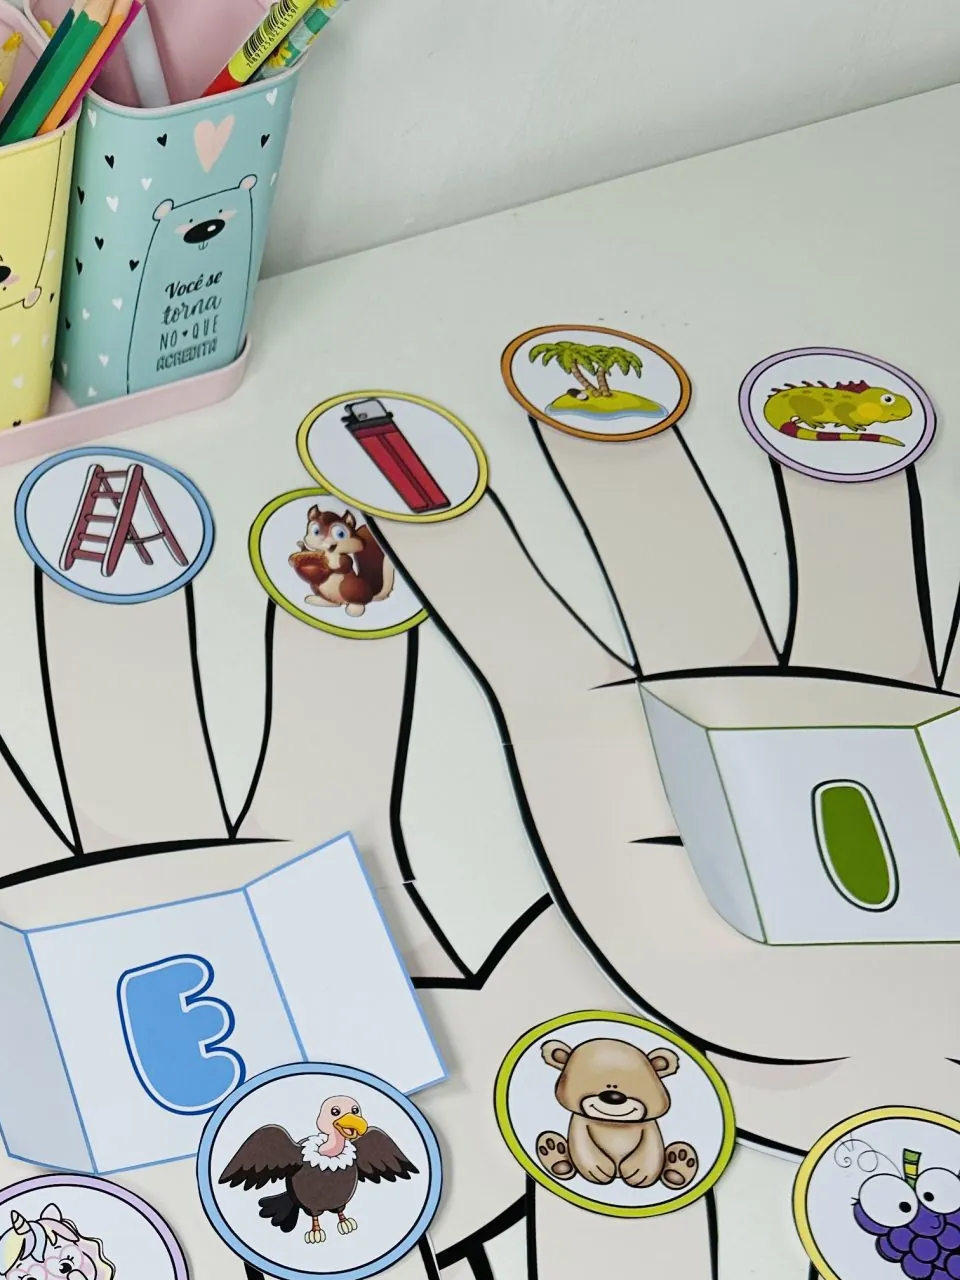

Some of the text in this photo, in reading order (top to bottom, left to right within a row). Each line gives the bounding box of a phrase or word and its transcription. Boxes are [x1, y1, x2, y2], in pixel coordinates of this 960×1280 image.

[165, 271, 223, 299] Você se
[161, 295, 222, 325] torna
[160, 314, 218, 351] NO QUE
[156, 336, 217, 372] ACREDITA
[117, 954, 246, 1116] E
